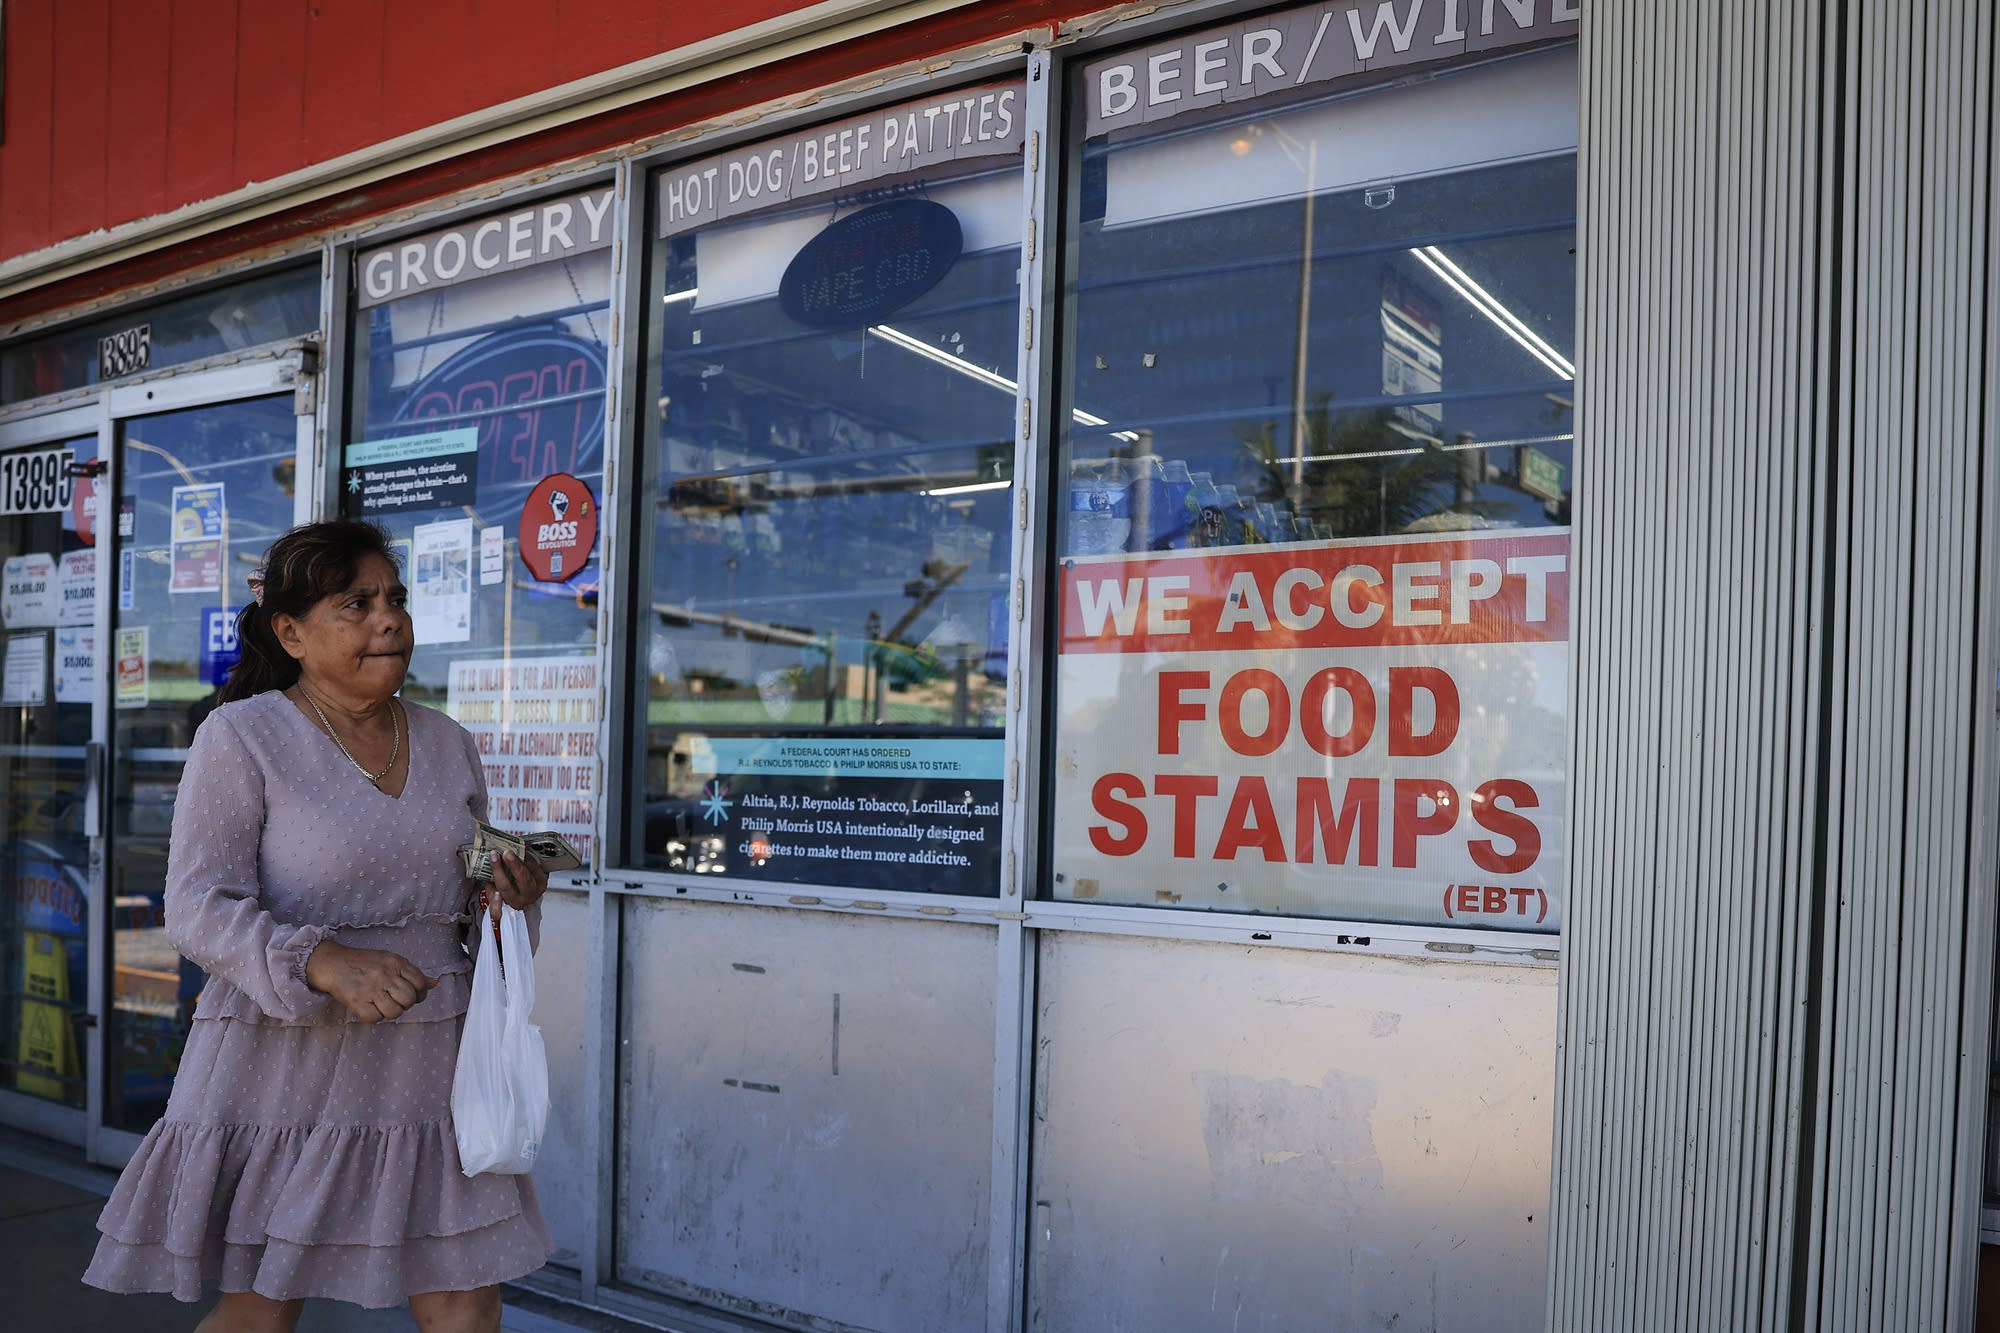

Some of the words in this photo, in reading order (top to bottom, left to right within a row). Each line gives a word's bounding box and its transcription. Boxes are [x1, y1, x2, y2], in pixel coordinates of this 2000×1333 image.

[668, 167, 718, 223] HOT
[728, 125, 871, 204] DOG/BEEF
[882, 90, 1016, 163] PATTIES
[365, 190, 615, 299] GROCERY
[802, 264, 865, 312] VAPE
[875, 248, 931, 290] CBD
[412, 358, 587, 483] OPEN
[4, 452, 74, 511] 13895
[365, 471, 384, 481] When
[384, 471, 395, 481] you
[396, 467, 418, 477] smoke,
[418, 465, 429, 475] the
[429, 462, 457, 474] nicotine
[363, 496, 377, 509] why
[377, 493, 402, 508] quitting
[402, 493, 408, 503] is
[409, 495, 416, 503] so
[416, 490, 434, 501] hard.
[364, 483, 388, 495] actually
[388, 481, 414, 493] changes
[414, 479, 425, 489] the
[537, 520, 578, 542] BOSS
[537, 539, 577, 550] REVOLUTION
[1076, 574, 1191, 638] WE
[1215, 554, 1567, 634] ACCEPT
[208, 611, 237, 652] EB
[541, 665, 560, 691] ANY
[562, 664, 597, 690] PERSON
[1156, 664, 1462, 758] FOOD
[499, 731, 516, 756] ANY
[519, 731, 564, 757] ALCOHOLIC
[780, 748, 786, 756] A
[787, 747, 822, 757] FEDERAL
[823, 748, 851, 757] COURT
[853, 748, 869, 757] HAS
[871, 748, 911, 758] ORDERED
[483, 764, 505, 788] TORE
[508, 765, 520, 789] OR
[523, 765, 553, 790] WITHIN
[557, 766, 572, 791] 100
[753, 760, 793, 769] REYNOLDS
[794, 760, 831, 769] TOBACCO
[833, 760, 839, 769] &
[840, 760, 866, 770] PHILIP
[867, 760, 899, 770] MORRIS
[900, 761, 918, 770] USA
[919, 761, 931, 770] TO
[932, 761, 961, 771] STATE:
[496, 797, 513, 821] THIS
[547, 799, 593, 825] VIOLATORS
[741, 794, 777, 811] Altria,
[779, 795, 800, 811] R.J.
[802, 796, 855, 813] Reynolds
[857, 797, 909, 816] Tobacco,
[912, 799, 972, 818] Lorillard,
[974, 802, 999, 816] and
[741, 817, 774, 834] Philip
[776, 818, 814, 833] Morris
[816, 820, 843, 834] USA
[845, 821, 925, 841] intentionally
[926, 825, 984, 844] designed
[1087, 771, 1543, 875] STAMPS
[739, 840, 792, 857] cigarettes
[794, 844, 805, 857] to
[807, 844, 839, 859] make
[840, 846, 873, 860] them
[874, 850, 907, 863] more
[908, 849, 971, 867] addictive.
[1442, 883, 1550, 925] (EBT)
